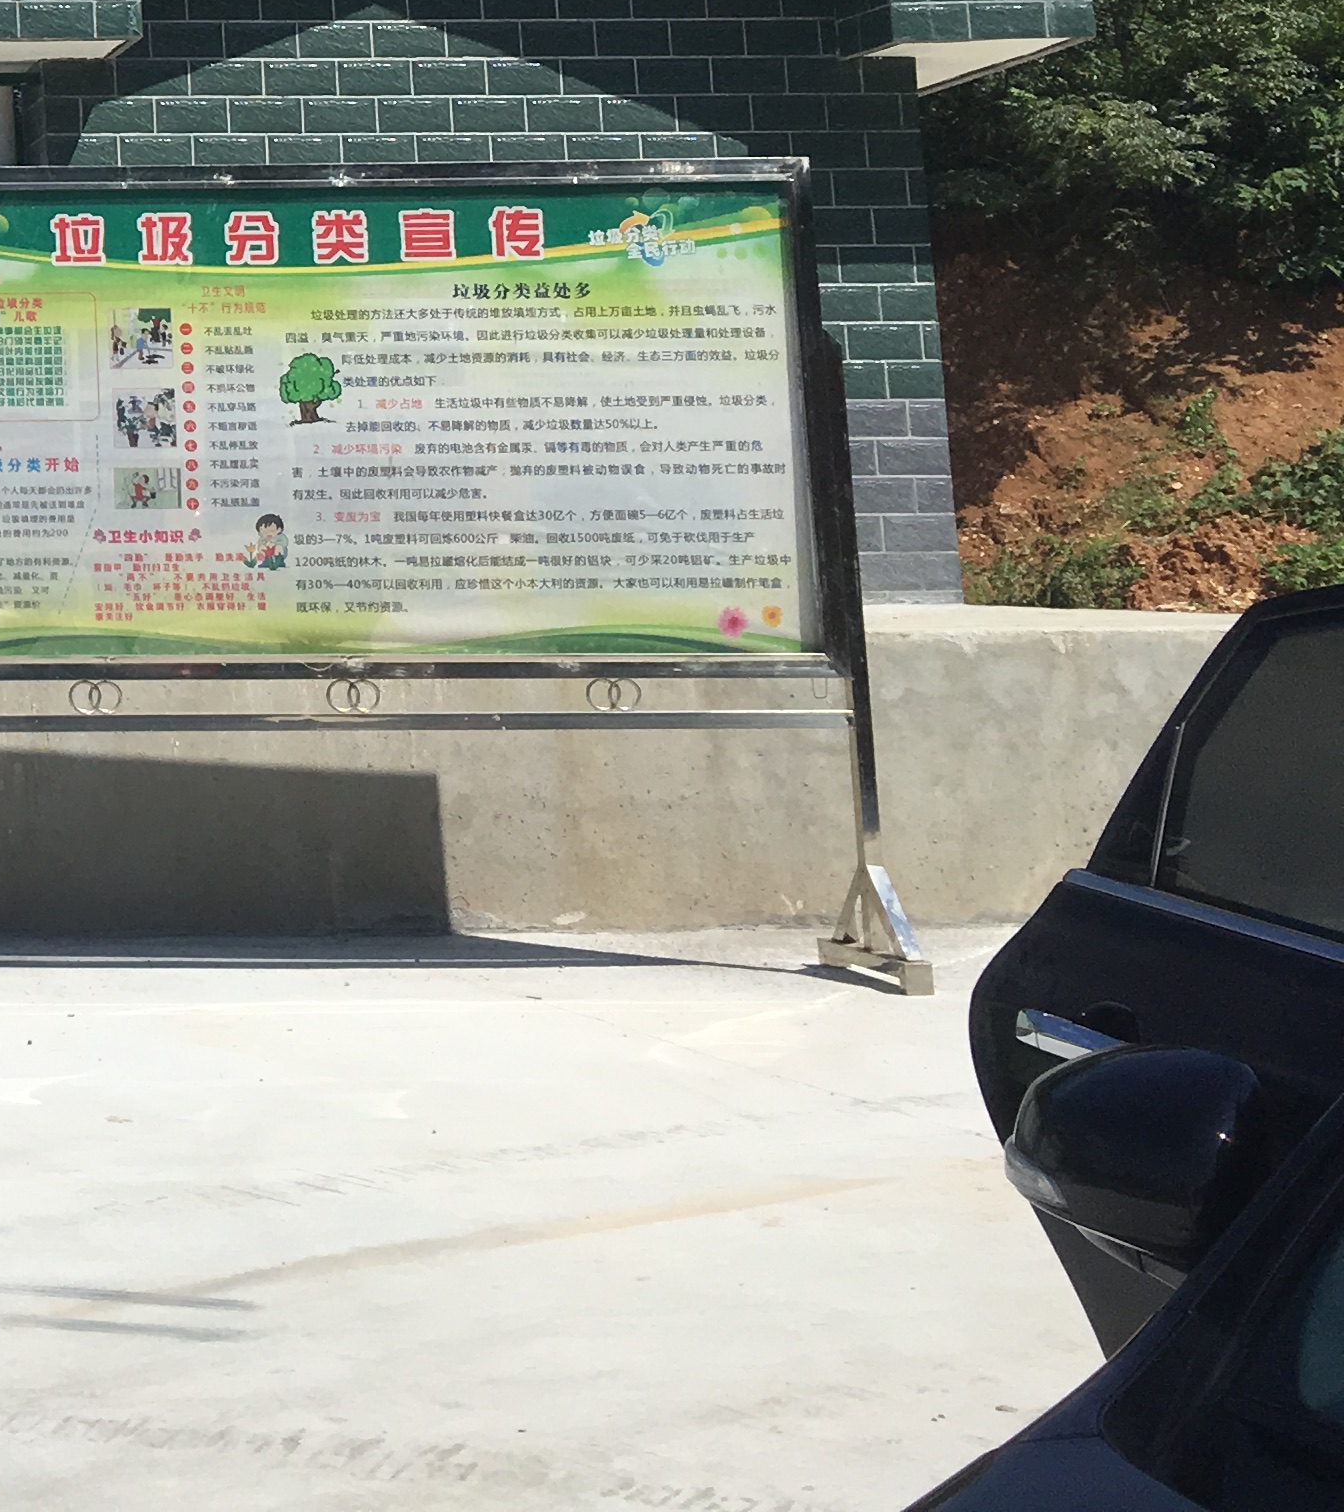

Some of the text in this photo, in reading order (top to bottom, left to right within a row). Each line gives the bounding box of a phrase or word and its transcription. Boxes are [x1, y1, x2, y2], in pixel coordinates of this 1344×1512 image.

[50, 206, 546, 266] 垃圾分类宣传
[588, 225, 660, 246] 垃圾分类
[626, 238, 697, 260] 全民行动
[452, 282, 592, 300] 垃圾分类益处多
[108, 529, 184, 544] 卫生小知识
